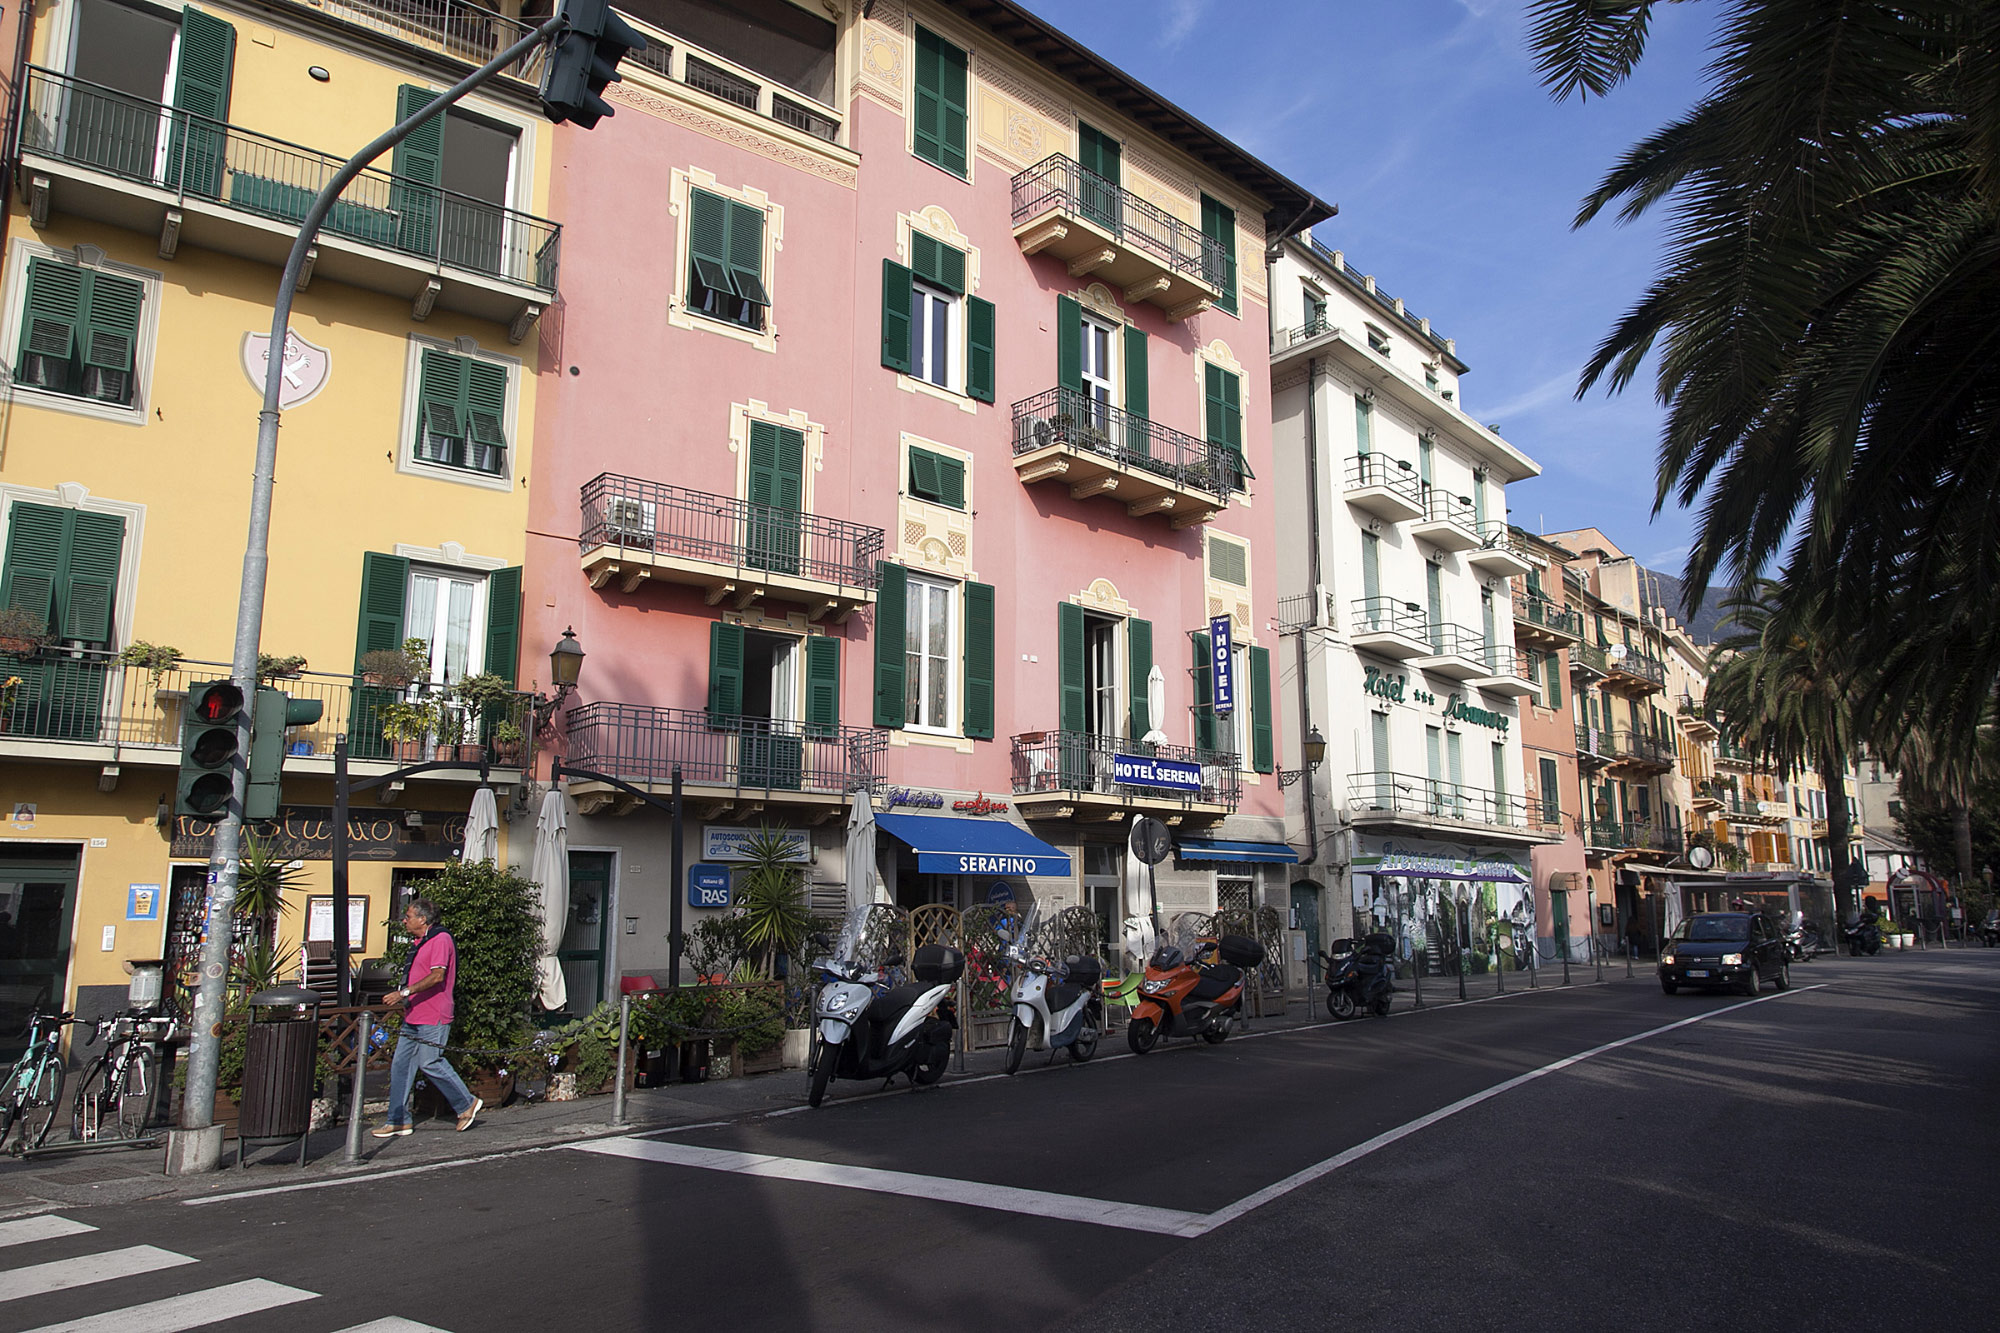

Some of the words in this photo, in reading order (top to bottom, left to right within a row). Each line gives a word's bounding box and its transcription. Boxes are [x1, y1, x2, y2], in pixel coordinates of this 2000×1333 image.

[1215, 634, 1229, 701] HOTEL
[1363, 665, 1406, 704] Hotel
[1215, 702, 1233, 710] SERENA
[1115, 762, 1155, 780] HOTEL
[1156, 767, 1201, 785] SERENA
[959, 856, 1036, 874] SERAFINO
[1375, 841, 1456, 874] Arenzano
[701, 889, 728, 904] RAS
